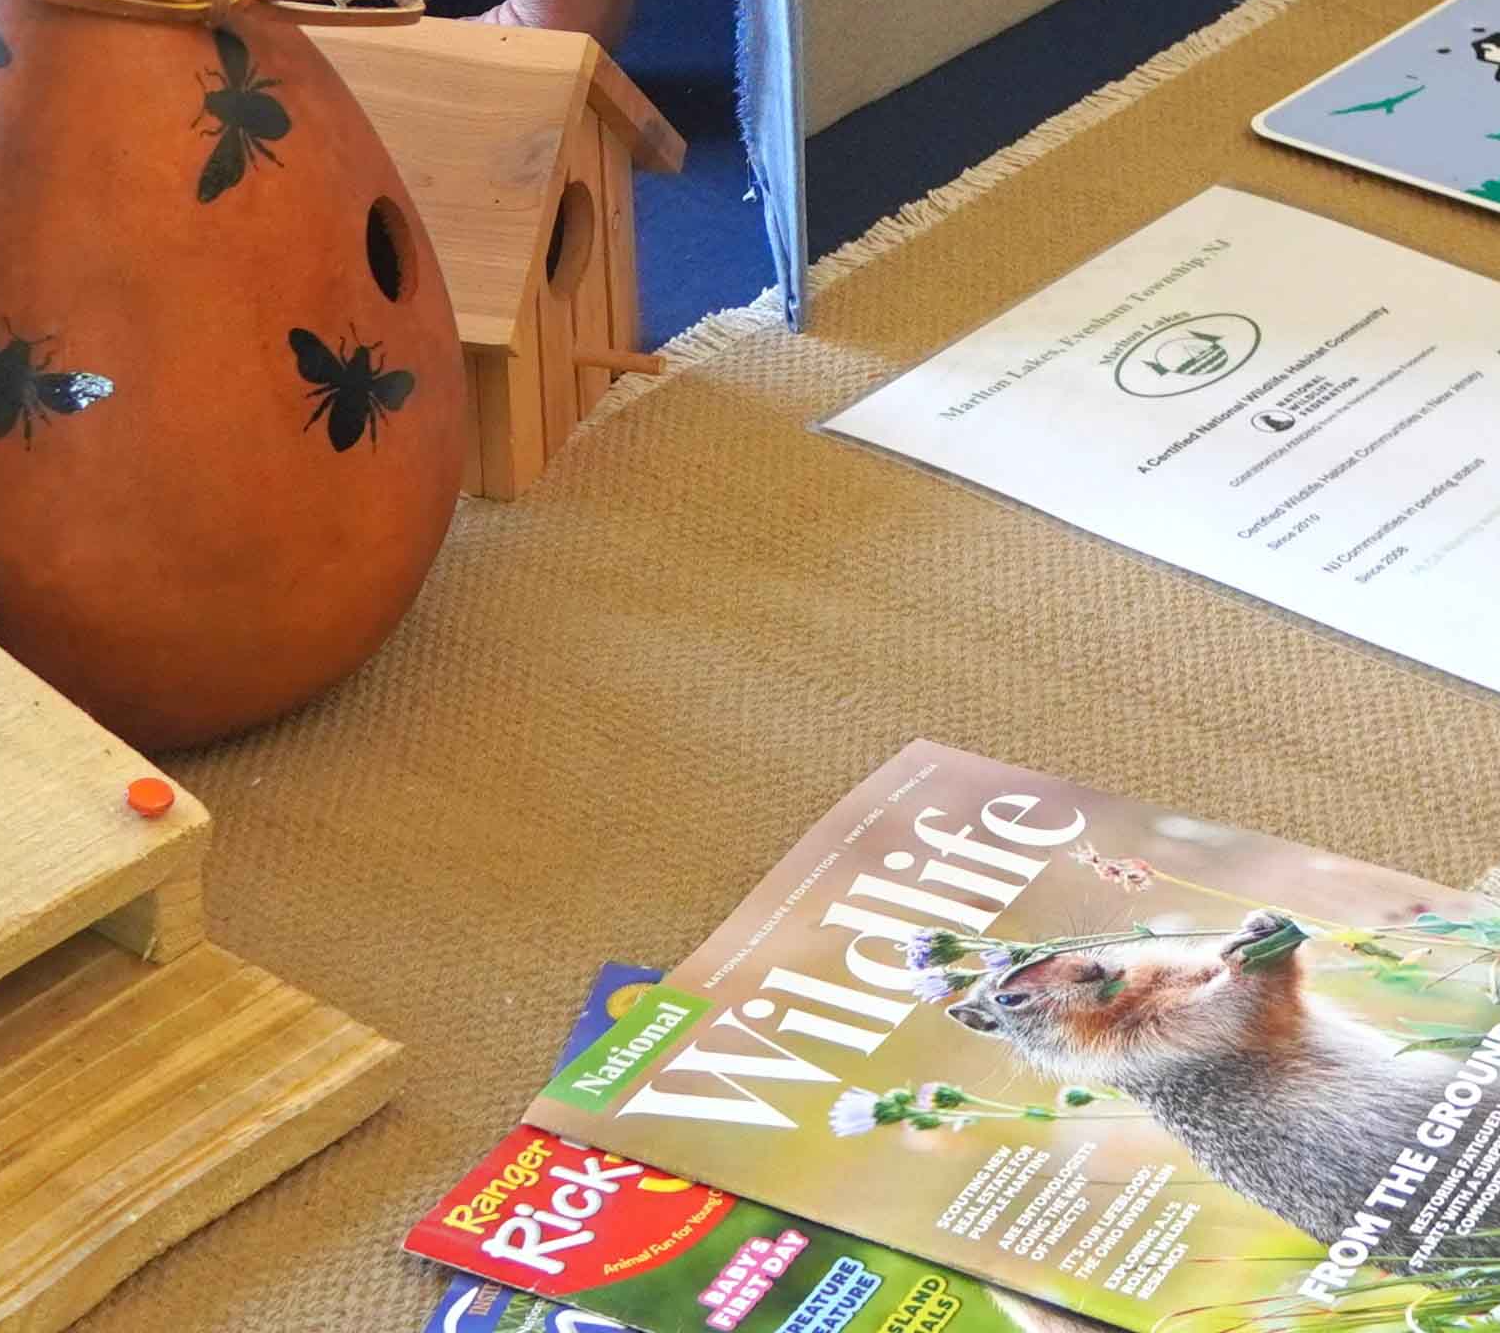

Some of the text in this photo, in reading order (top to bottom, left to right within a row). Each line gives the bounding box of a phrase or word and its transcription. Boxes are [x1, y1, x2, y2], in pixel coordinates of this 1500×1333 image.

[939, 379, 1013, 417] Marlton
[1005, 348, 1068, 380] Lakes,
[1059, 306, 1129, 346] Evesham
[1129, 256, 1212, 302] Township,
[1099, 308, 1192, 368] Marlton Lakes
[1137, 465, 1151, 474] A
[1146, 431, 1201, 467] Certified
[1195, 401, 1248, 435] National
[1241, 373, 1290, 403] Wildlife
[1284, 346, 1330, 374] Habitat
[1324, 306, 1389, 348] Community
[1275, 375, 1326, 408] NATIONAL
[1287, 381, 1334, 411] WILDLIFE
[1299, 376, 1360, 417] FEDERATION
[1237, 507, 1287, 539] Certified
[1279, 482, 1325, 509] Wildlife
[1317, 456, 1361, 484] Habitat
[1354, 413, 1423, 458] Communities
[1336, 514, 1409, 563] Communities
[1414, 479, 1460, 510] pending
[615, 791, 1086, 1128] Wildlife
[703, 947, 753, 989] NATIONAL
[747, 906, 789, 946] WILDLIFE
[785, 852, 840, 905] FEDERATION
[572, 1002, 693, 1096] National
[443, 1139, 554, 1235] Ranger
[481, 1157, 644, 1275] Rick
[936, 1146, 1012, 1229] SCOUTING NEW
[951, 1146, 1035, 1235] REAL ESTATE FOR
[967, 1150, 1052, 1240] PURPLE MARTINS
[998, 1140, 1098, 1250] ARE ENTOMOLOGISTS
[1014, 1172, 1088, 1256] GOING THE WAY
[1030, 1196, 1090, 1261] OF INSECTS?
[1074, 1164, 1176, 1278] THE OHIO RIVER BASIN
[1295, 1210, 1392, 1307] FROM
[1364, 1147, 1439, 1209] THE
[1408, 1220, 1450, 1269] STARTS
[1440, 1188, 1474, 1222] WITH
[1466, 1180, 1482, 1190] A
[1409, 1167, 1466, 1234] RESTORING
[603, 1197, 723, 1275] Animal Fun for Young
[703, 1239, 771, 1306] BABY'S
[713, 1232, 808, 1328] FIRST DAY
[1079, 1225, 1106, 1250] OUR
[1103, 1228, 1161, 1290] EXPLORING
[1120, 1203, 1201, 1295] ROLE IN WILDLIFE
[1137, 1242, 1189, 1300] RESEARCH
